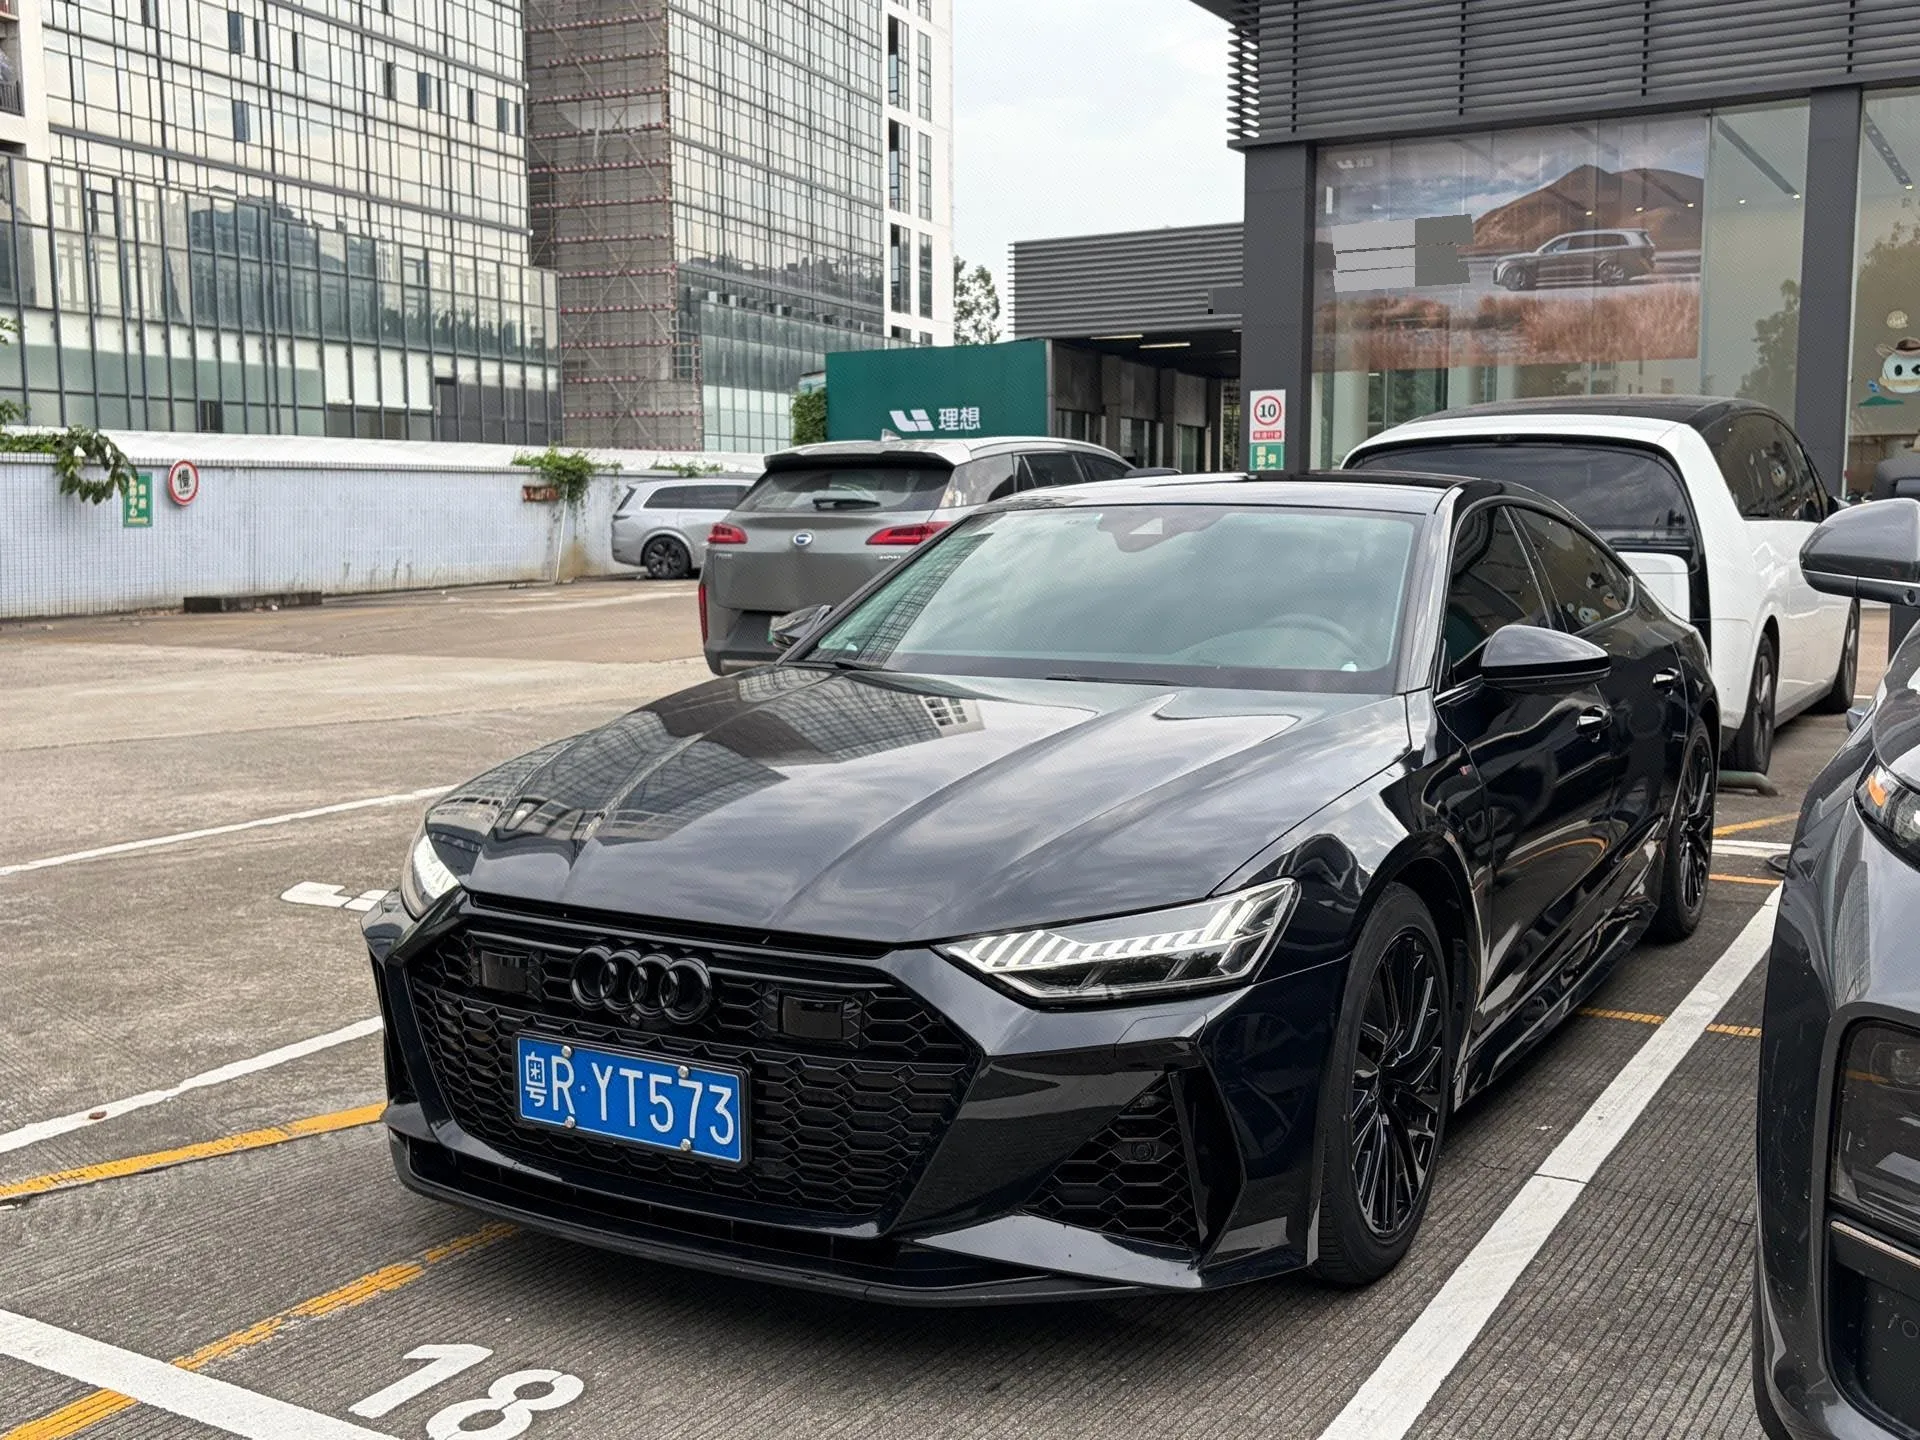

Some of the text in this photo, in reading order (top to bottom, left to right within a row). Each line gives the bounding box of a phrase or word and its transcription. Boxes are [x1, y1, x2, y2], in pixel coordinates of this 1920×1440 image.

[938, 407, 981, 431] 理想
[1260, 404, 1277, 418] 10
[348, 1343, 584, 1440] 18
